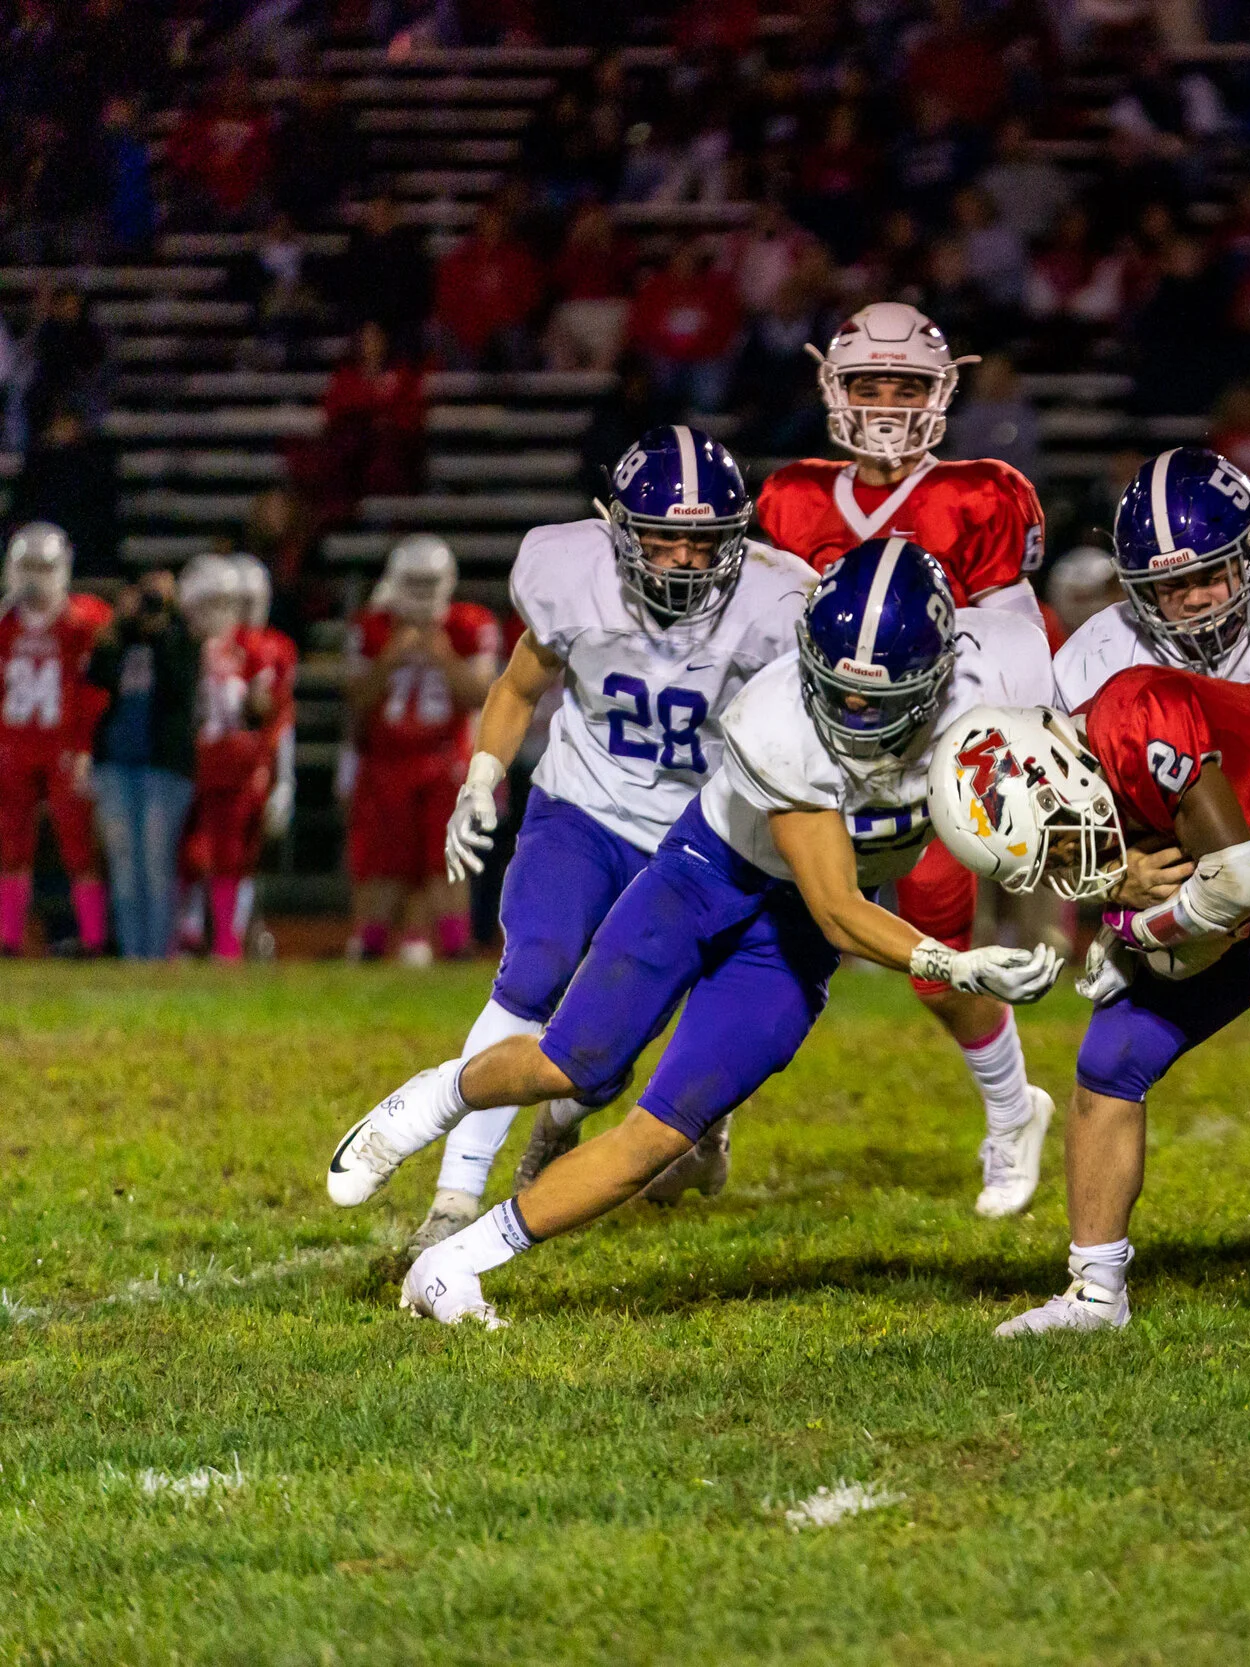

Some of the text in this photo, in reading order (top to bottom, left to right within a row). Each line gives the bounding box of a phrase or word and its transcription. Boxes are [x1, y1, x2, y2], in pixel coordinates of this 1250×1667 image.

[673, 506, 710, 515] Riddell
[1152, 551, 1189, 569] Riddell
[843, 662, 883, 678] Riddell
[603, 671, 709, 775] 28
[1146, 740, 1194, 793] 2
